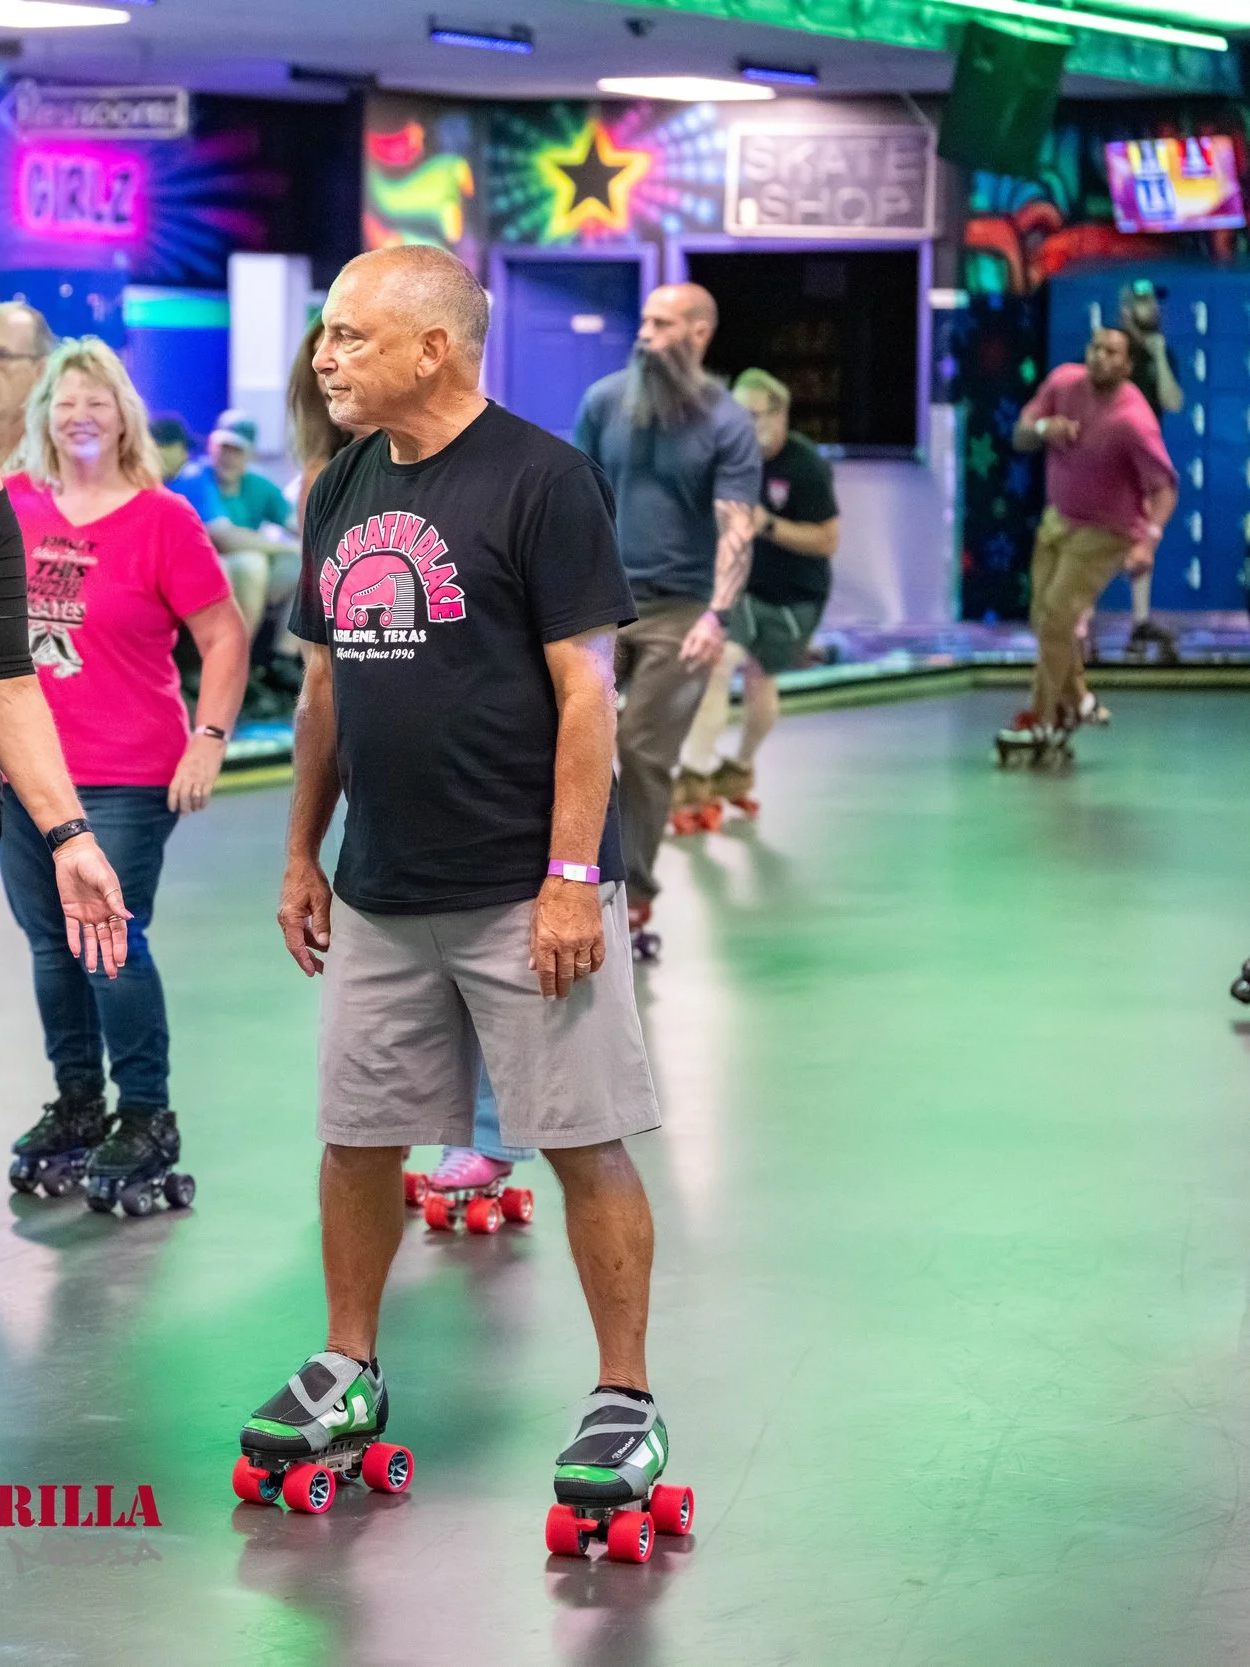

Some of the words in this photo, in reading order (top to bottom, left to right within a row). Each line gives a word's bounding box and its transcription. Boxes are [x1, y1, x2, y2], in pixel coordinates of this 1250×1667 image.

[744, 135, 921, 183] SKATE
[22, 158, 137, 229] GIRLZ
[760, 183, 911, 225] SHOP
[336, 511, 426, 570] SKATIN
[409, 525, 466, 623] PLACE
[336, 647, 366, 662] Skating
[366, 648, 389, 659] Since
[390, 648, 415, 659] 1996
[383, 629, 427, 643] TEXAS
